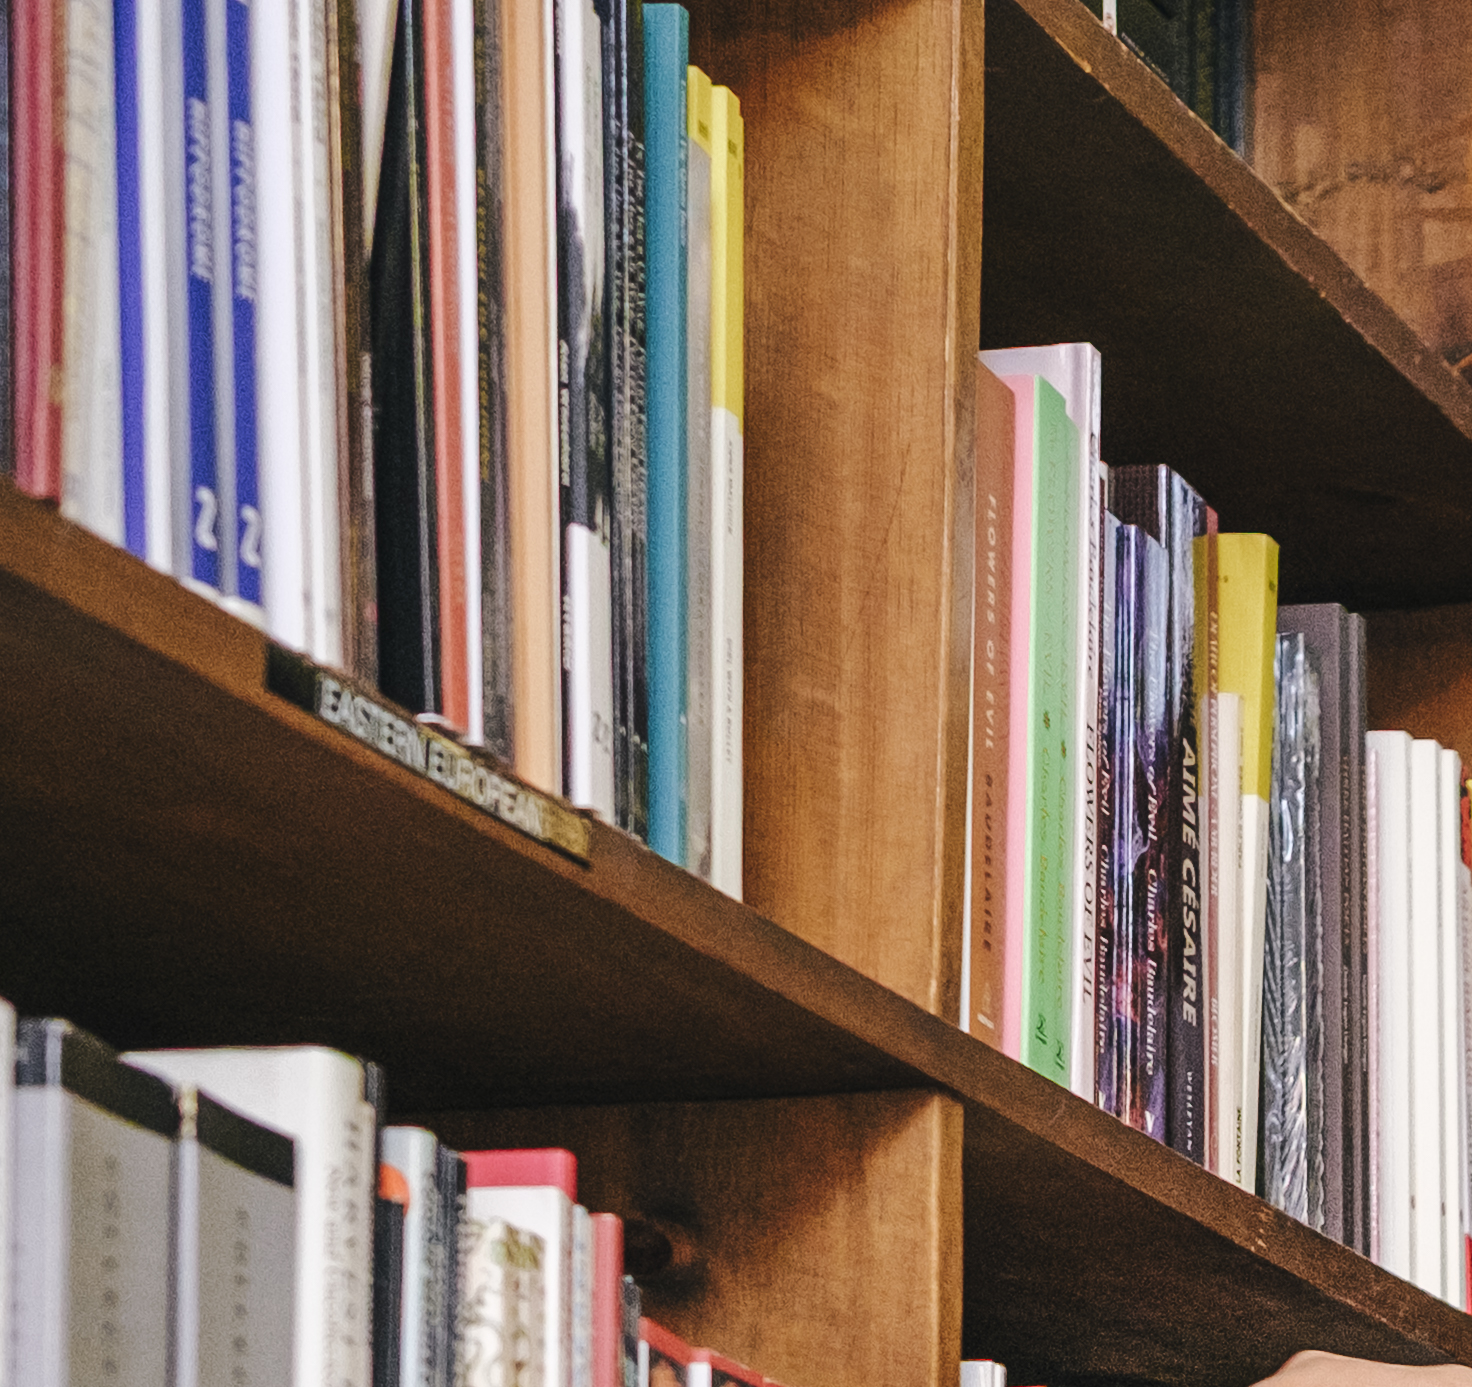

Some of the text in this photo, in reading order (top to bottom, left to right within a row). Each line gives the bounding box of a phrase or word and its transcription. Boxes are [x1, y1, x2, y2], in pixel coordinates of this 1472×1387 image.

[983, 494, 996, 953] FLOWERS OF EVIL BAUDELAIRE
[1182, 738, 1198, 847] AIMÉ
[1083, 721, 1094, 1005] FLOWERS OF EVIL
[1147, 868, 1157, 951] Charles
[1182, 857, 1199, 1027] CÉSAIRE
